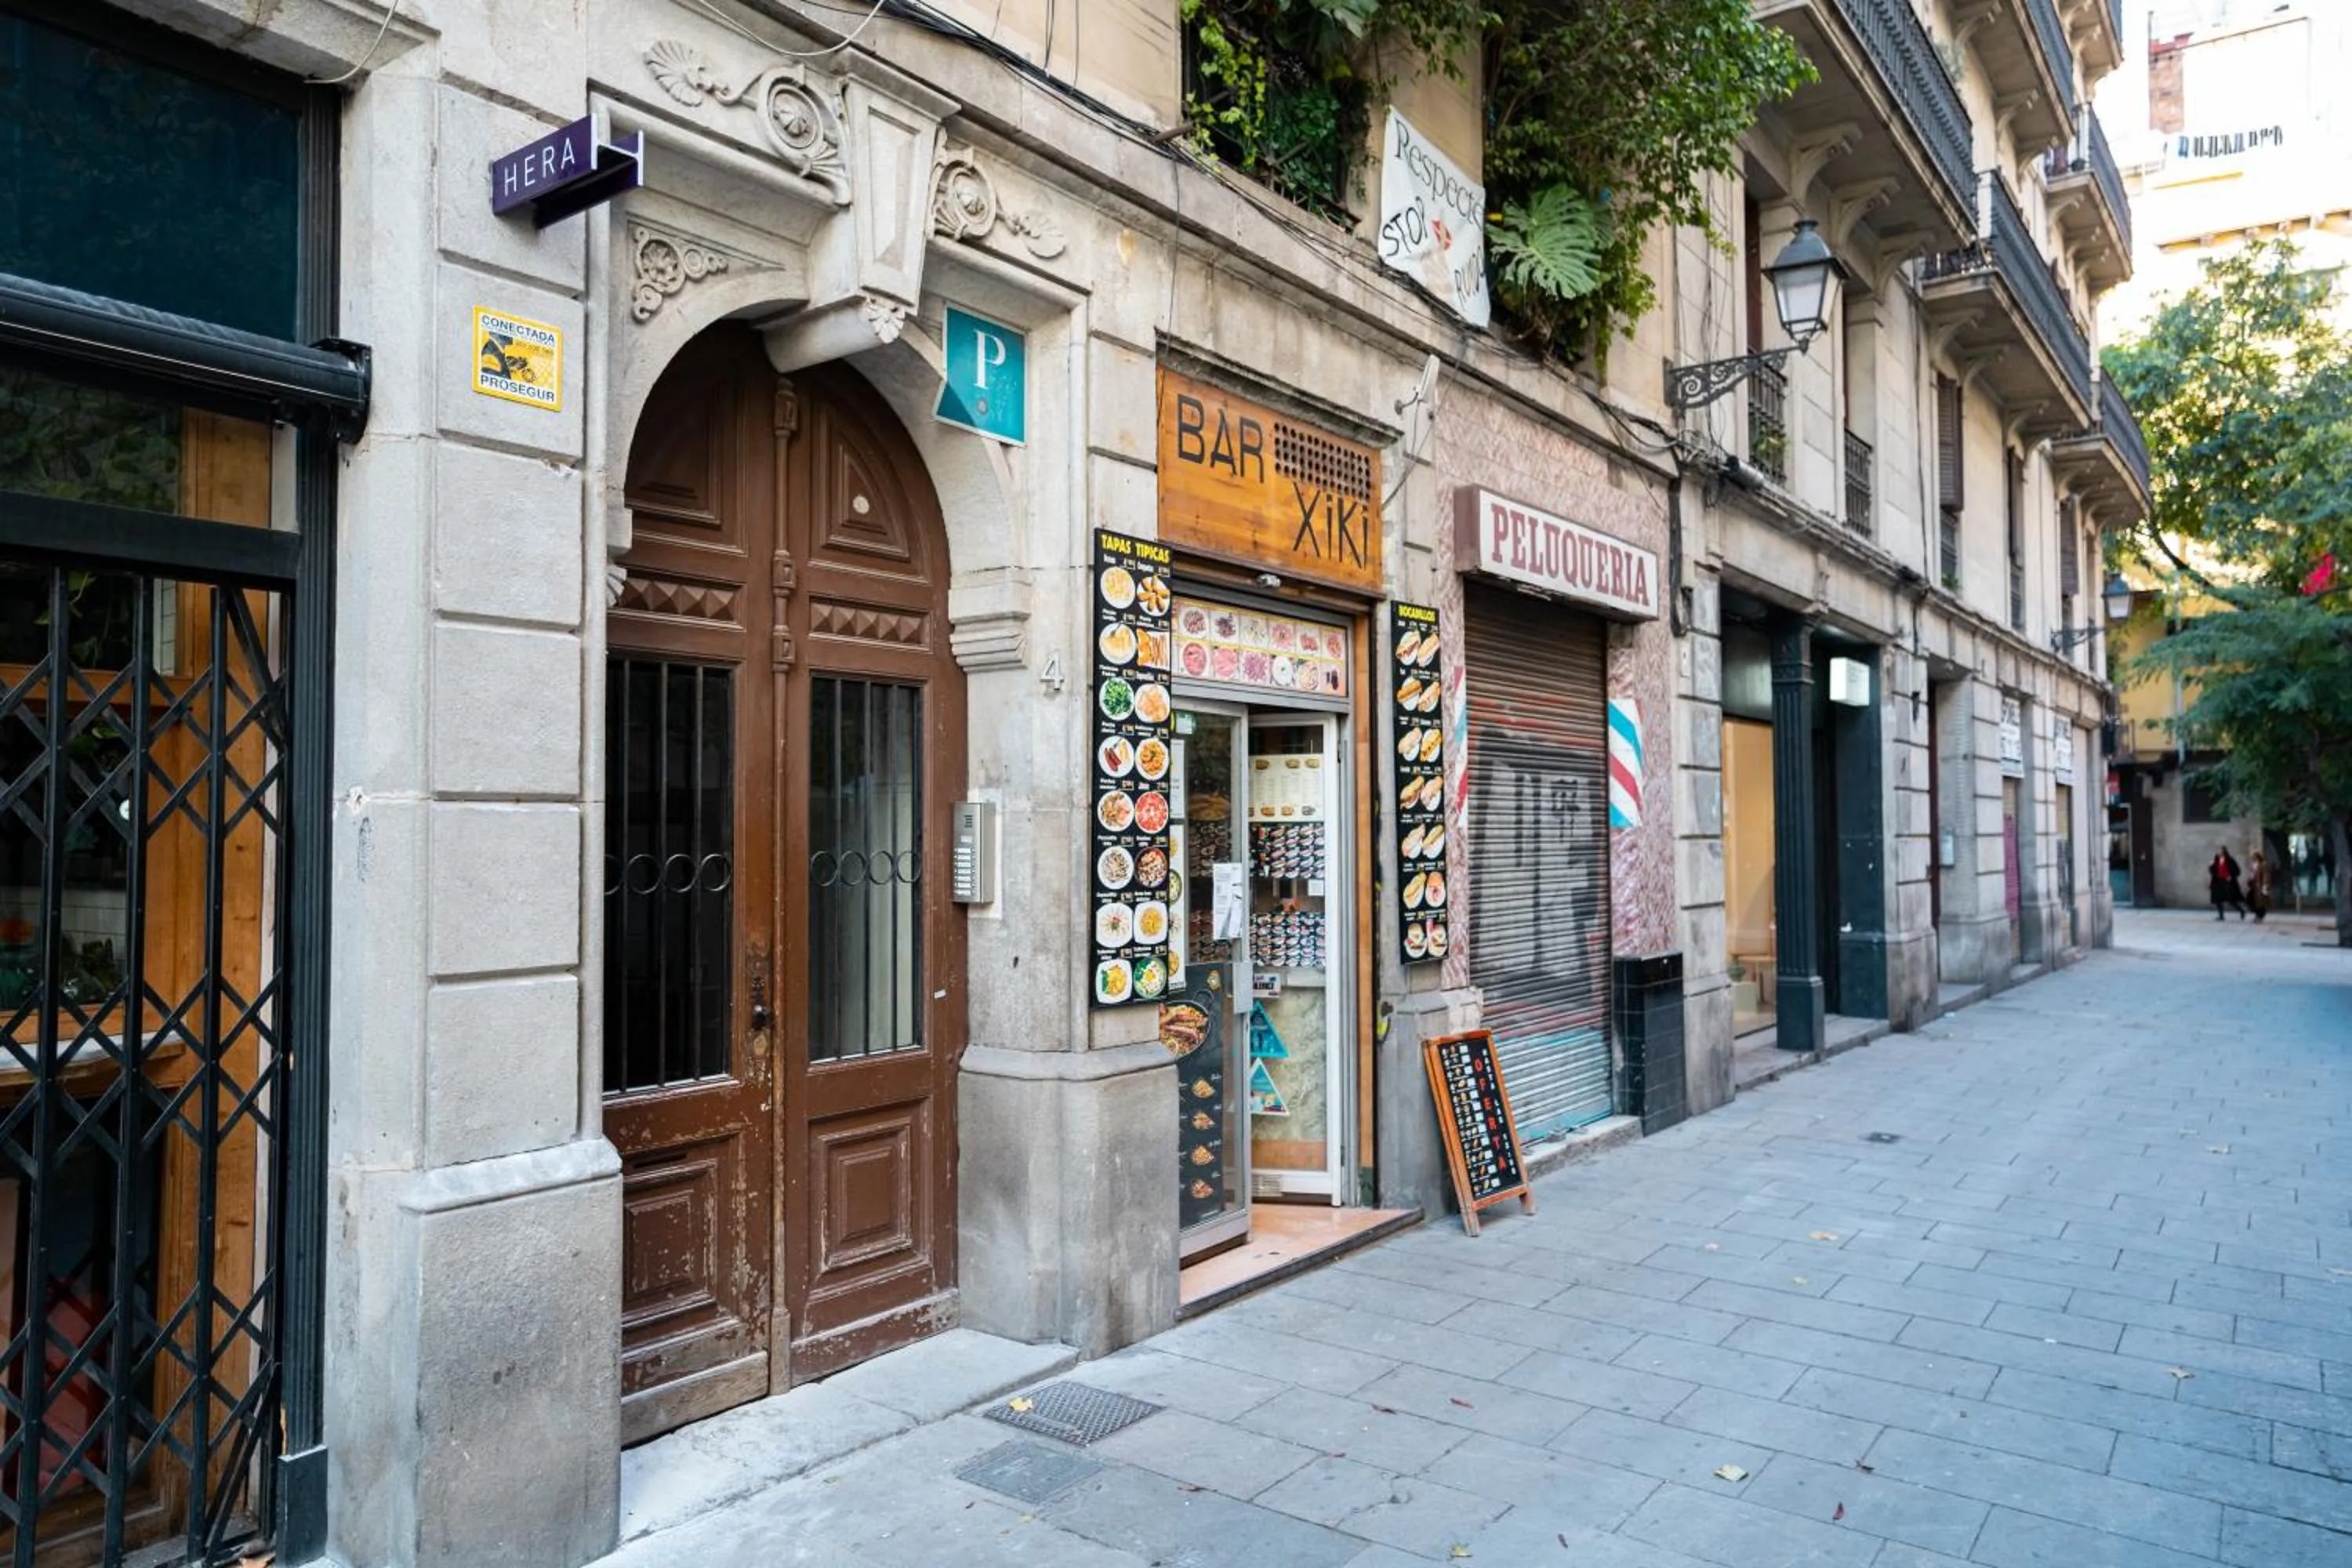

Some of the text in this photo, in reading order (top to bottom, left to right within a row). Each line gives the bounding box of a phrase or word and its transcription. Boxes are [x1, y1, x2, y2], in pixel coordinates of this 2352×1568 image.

[503, 136, 575, 197] HERA
[1382, 195, 1428, 257] STOP
[481, 314, 555, 343] CONECTADA
[974, 328, 1007, 390] P
[481, 374, 555, 402] PROSEGUR
[1178, 393, 1265, 484] BAR
[1101, 534, 1131, 555] TAPAS
[1135, 542, 1171, 564] TIPICAS
[1490, 503, 1650, 607] PELUQUERIA
[1040, 653, 1065, 691] 4
